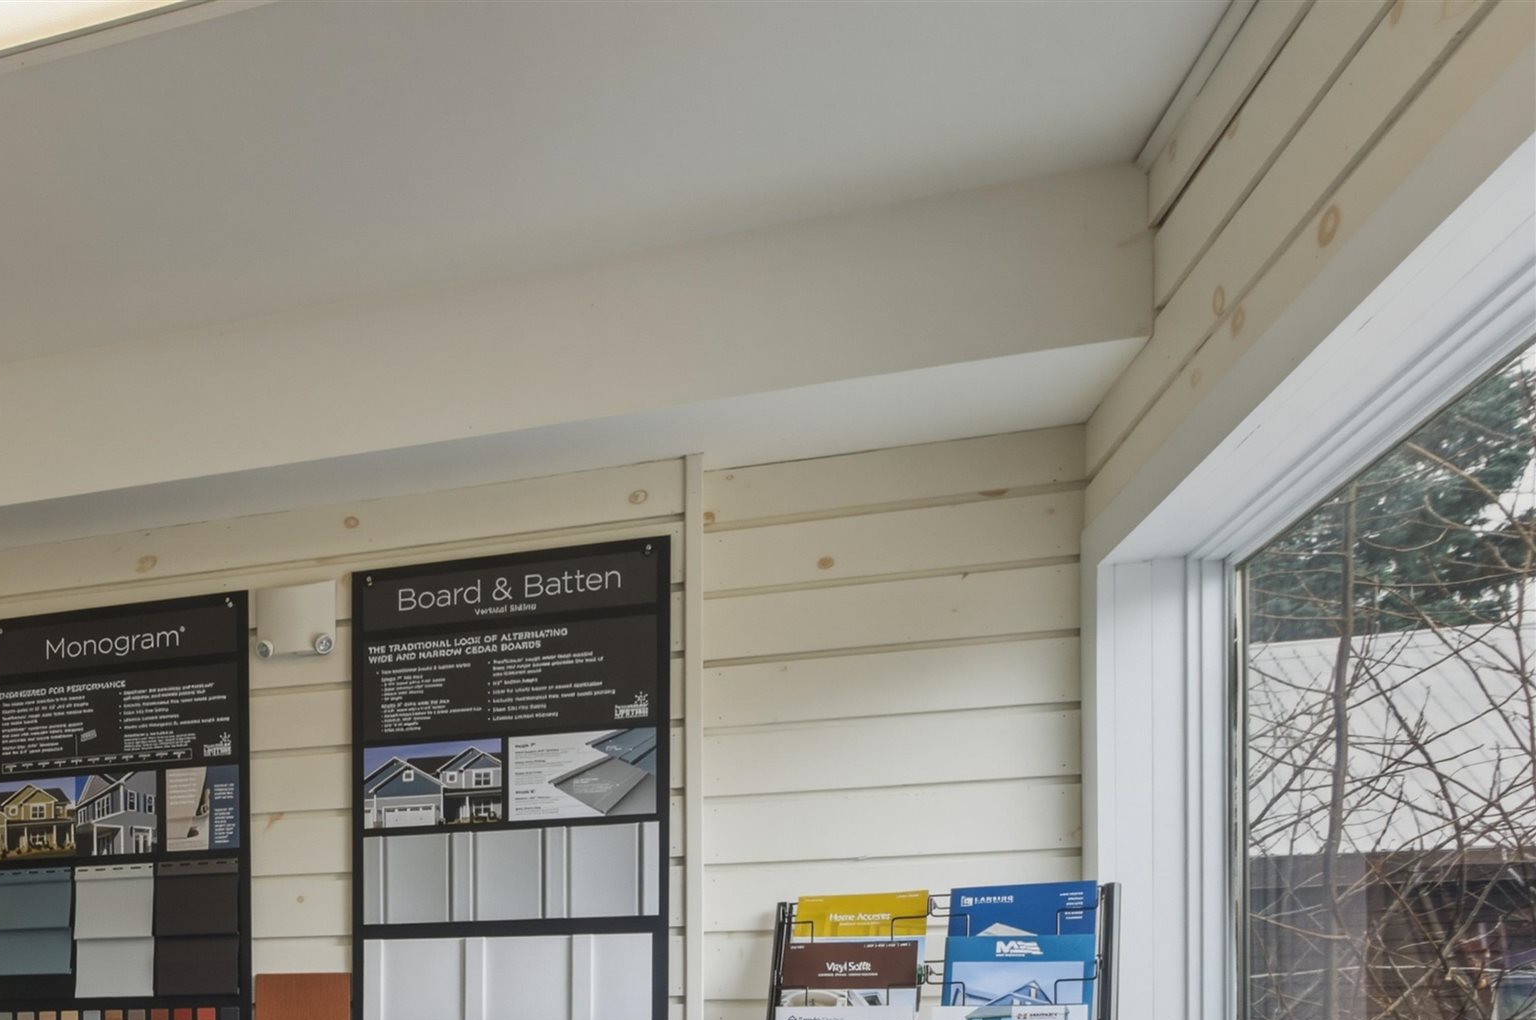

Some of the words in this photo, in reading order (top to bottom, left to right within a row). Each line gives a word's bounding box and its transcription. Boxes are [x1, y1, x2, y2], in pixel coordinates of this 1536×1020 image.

[397, 578, 482, 612] Board
[492, 576, 514, 601] &
[524, 568, 622, 598] Batten
[368, 645, 386, 655] THE
[388, 639, 452, 653] TRADITIONAL
[454, 635, 482, 647] LOOK
[484, 634, 498, 643] OF
[368, 654, 393, 664] WIDE
[396, 652, 417, 662] AND
[419, 648, 462, 660] NARROW
[465, 644, 498, 655] CEDAR
[500, 640, 542, 652] BOARDS
